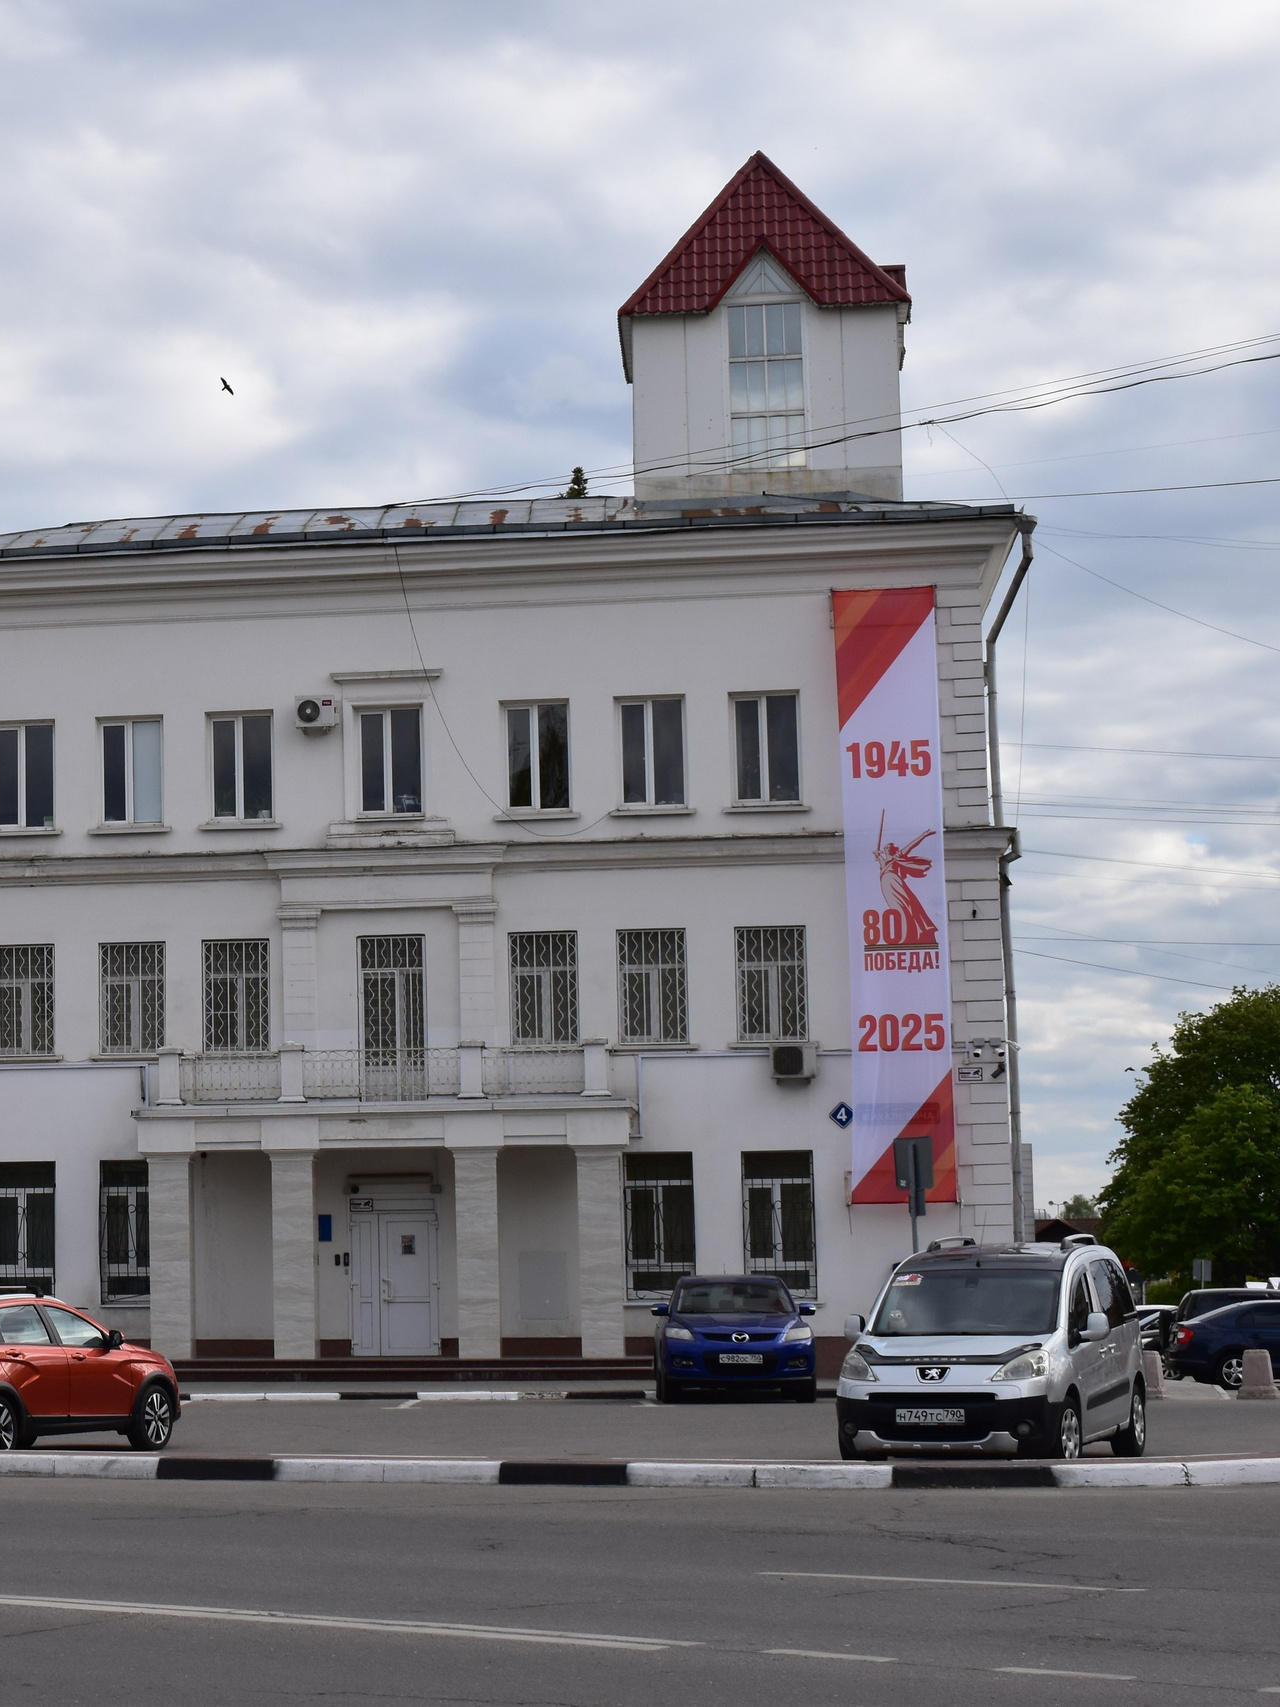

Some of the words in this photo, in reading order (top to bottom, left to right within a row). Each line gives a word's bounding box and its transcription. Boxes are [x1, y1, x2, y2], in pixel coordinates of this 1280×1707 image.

[845, 739, 932, 779] 1945
[862, 908, 903, 945] 80
[864, 951, 940, 973] ПОБЕДА!
[858, 1013, 945, 1052] 2025
[836, 1107, 848, 1121] 4
